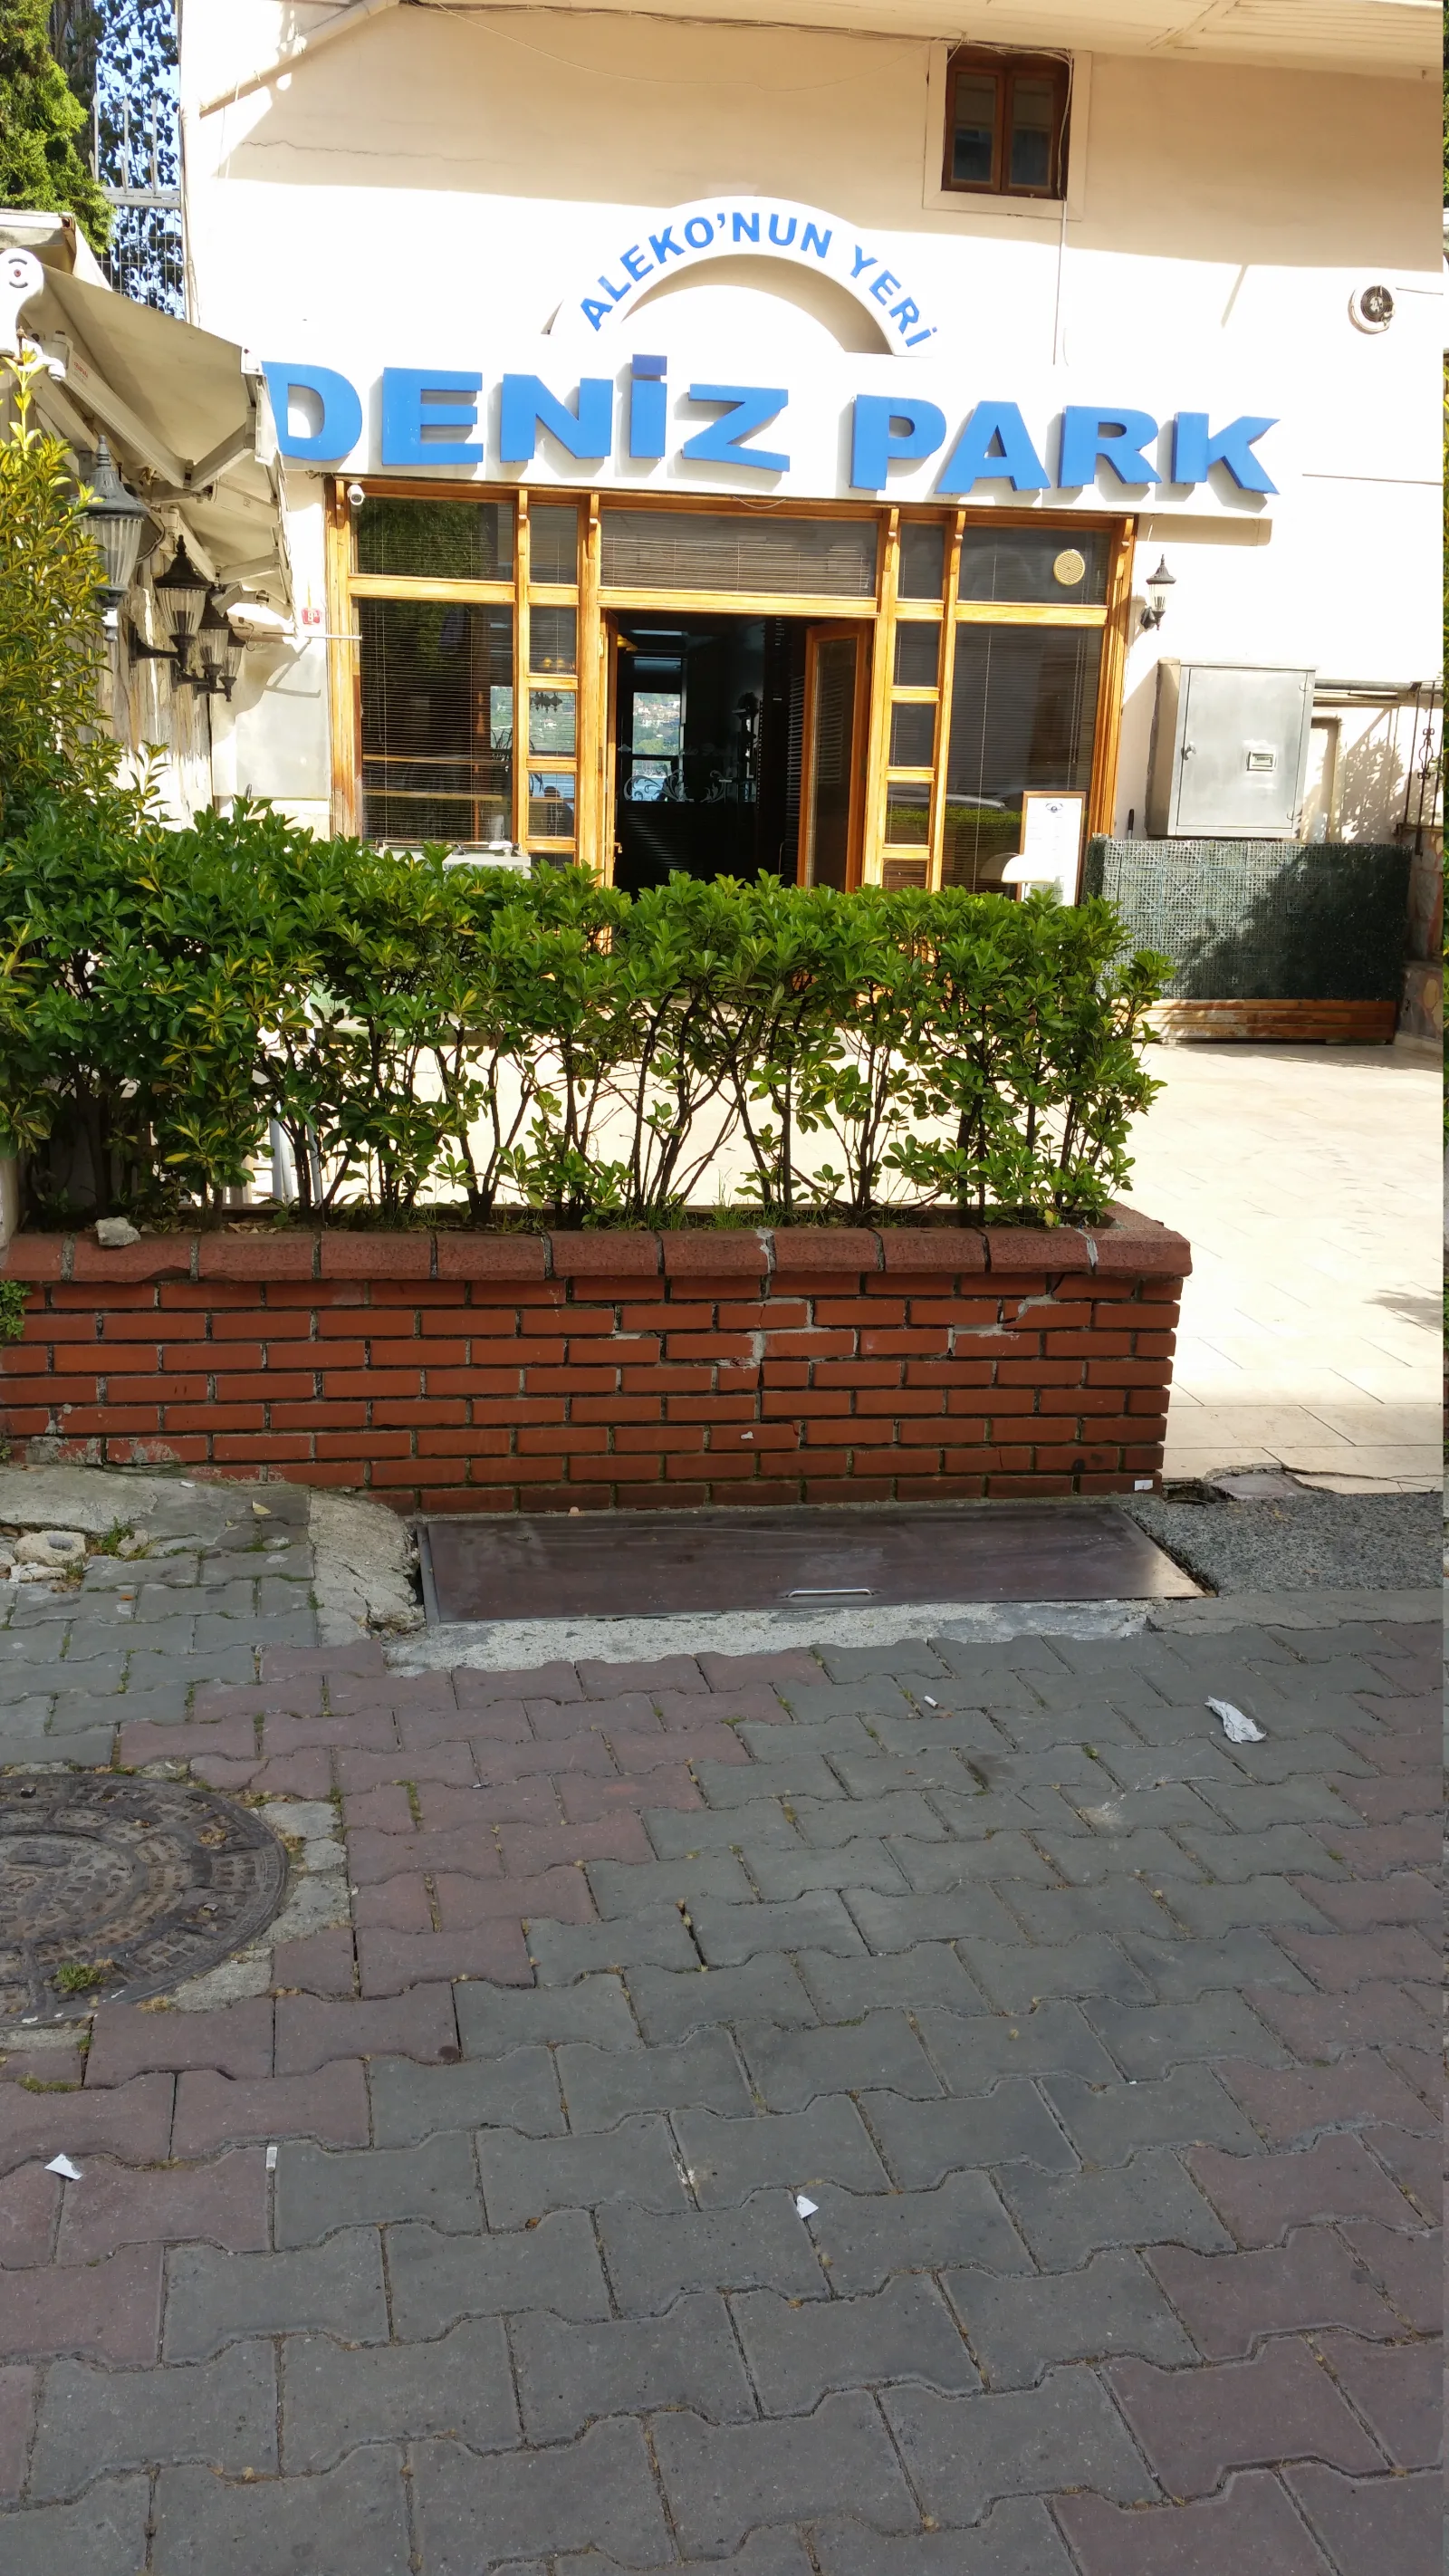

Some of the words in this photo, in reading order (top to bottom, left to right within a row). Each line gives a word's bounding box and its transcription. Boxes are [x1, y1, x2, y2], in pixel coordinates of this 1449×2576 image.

[851, 245, 938, 348] YERİ
[261, 354, 790, 471] DENİZ
[849, 394, 1280, 495] PARK
